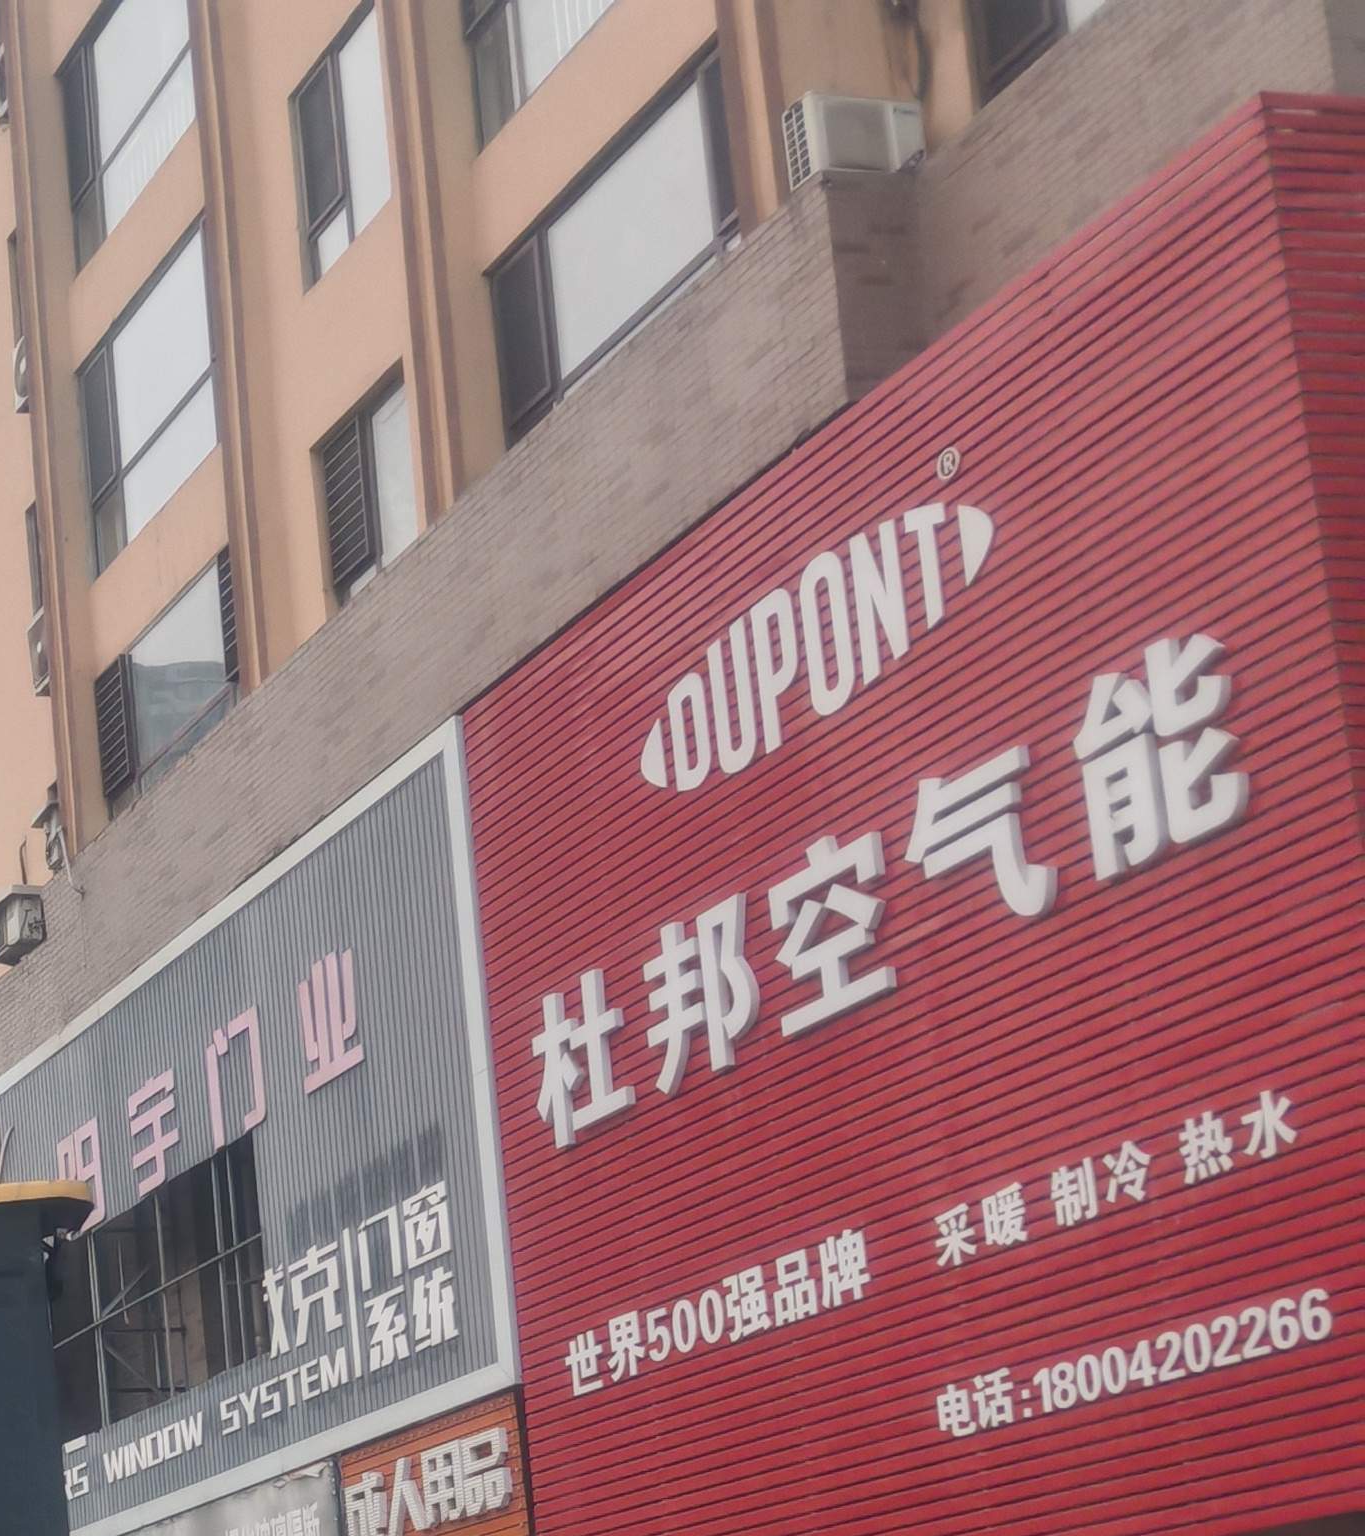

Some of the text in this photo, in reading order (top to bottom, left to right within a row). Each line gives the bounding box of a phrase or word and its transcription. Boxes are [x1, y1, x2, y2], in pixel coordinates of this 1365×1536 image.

[666, 501, 947, 793] DUPONT
[532, 632, 1250, 1149] 杜邦空气能
[357, 1180, 452, 1292] 门窗
[934, 1089, 1298, 1268] 采暖 制冷 热水
[364, 1266, 460, 1373] 系统
[565, 1228, 871, 1398] 世界500强品牌
[936, 1288, 1333, 1440] 电话:18004202266
[102, 1411, 203, 1484] WINDOW
[220, 1346, 349, 1437] SYSTEM
